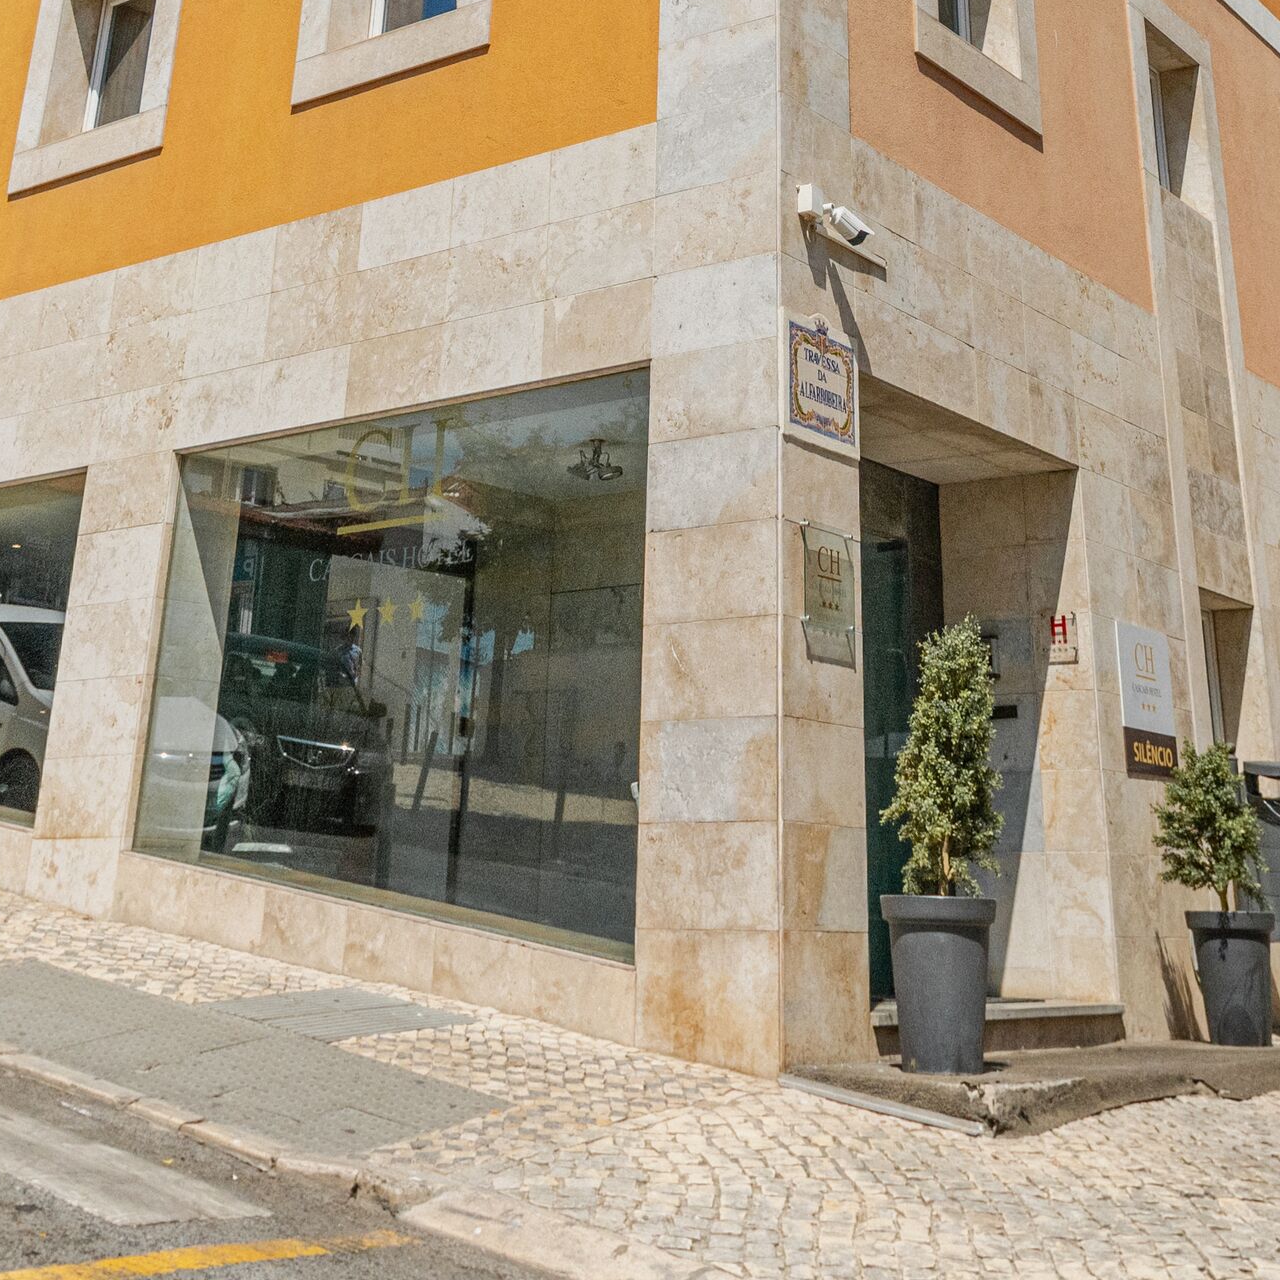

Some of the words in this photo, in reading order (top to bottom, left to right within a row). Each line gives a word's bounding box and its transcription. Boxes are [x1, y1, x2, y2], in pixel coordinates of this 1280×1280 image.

[804, 348, 840, 373] TRAVESSA
[817, 369, 827, 383] DA
[309, 548, 397, 582] CACAIS
[817, 546, 841, 576] CH
[1135, 642, 1154, 674] CH
[1133, 739, 1173, 768] SILÊNCIO
